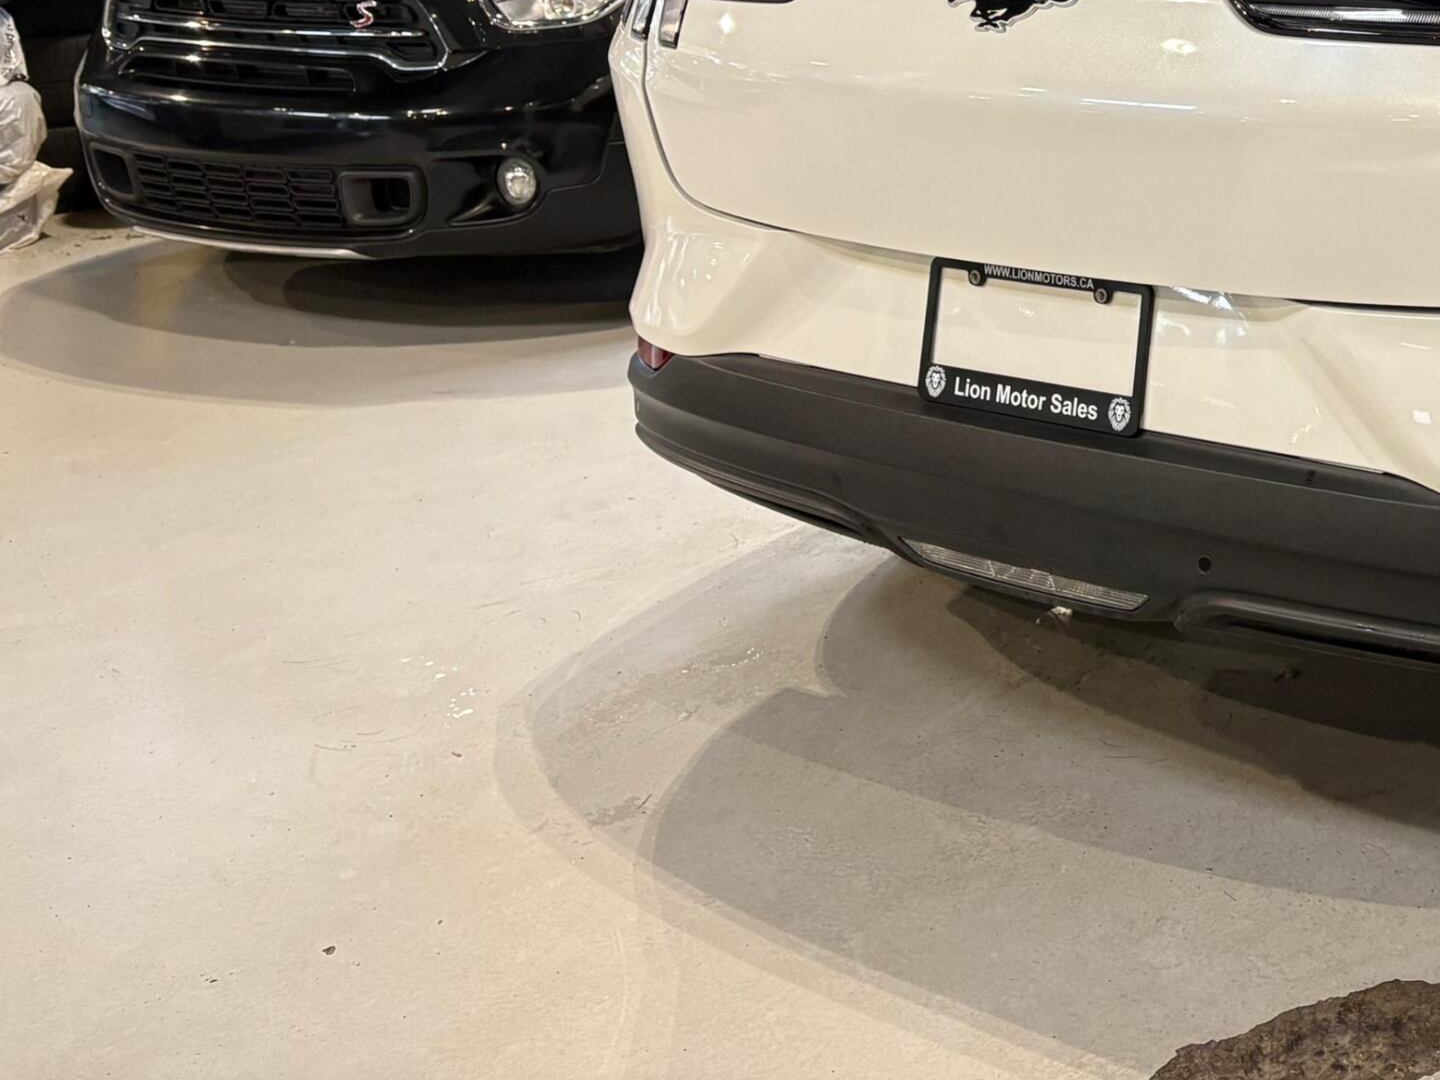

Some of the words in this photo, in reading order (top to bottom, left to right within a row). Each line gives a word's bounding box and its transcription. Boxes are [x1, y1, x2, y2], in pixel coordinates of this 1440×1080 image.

[983, 264, 1095, 289] WWW.LIONMOTORS.CA
[954, 377, 991, 401] Lion
[996, 384, 1046, 410] Motor
[1050, 393, 1098, 420] Sales
